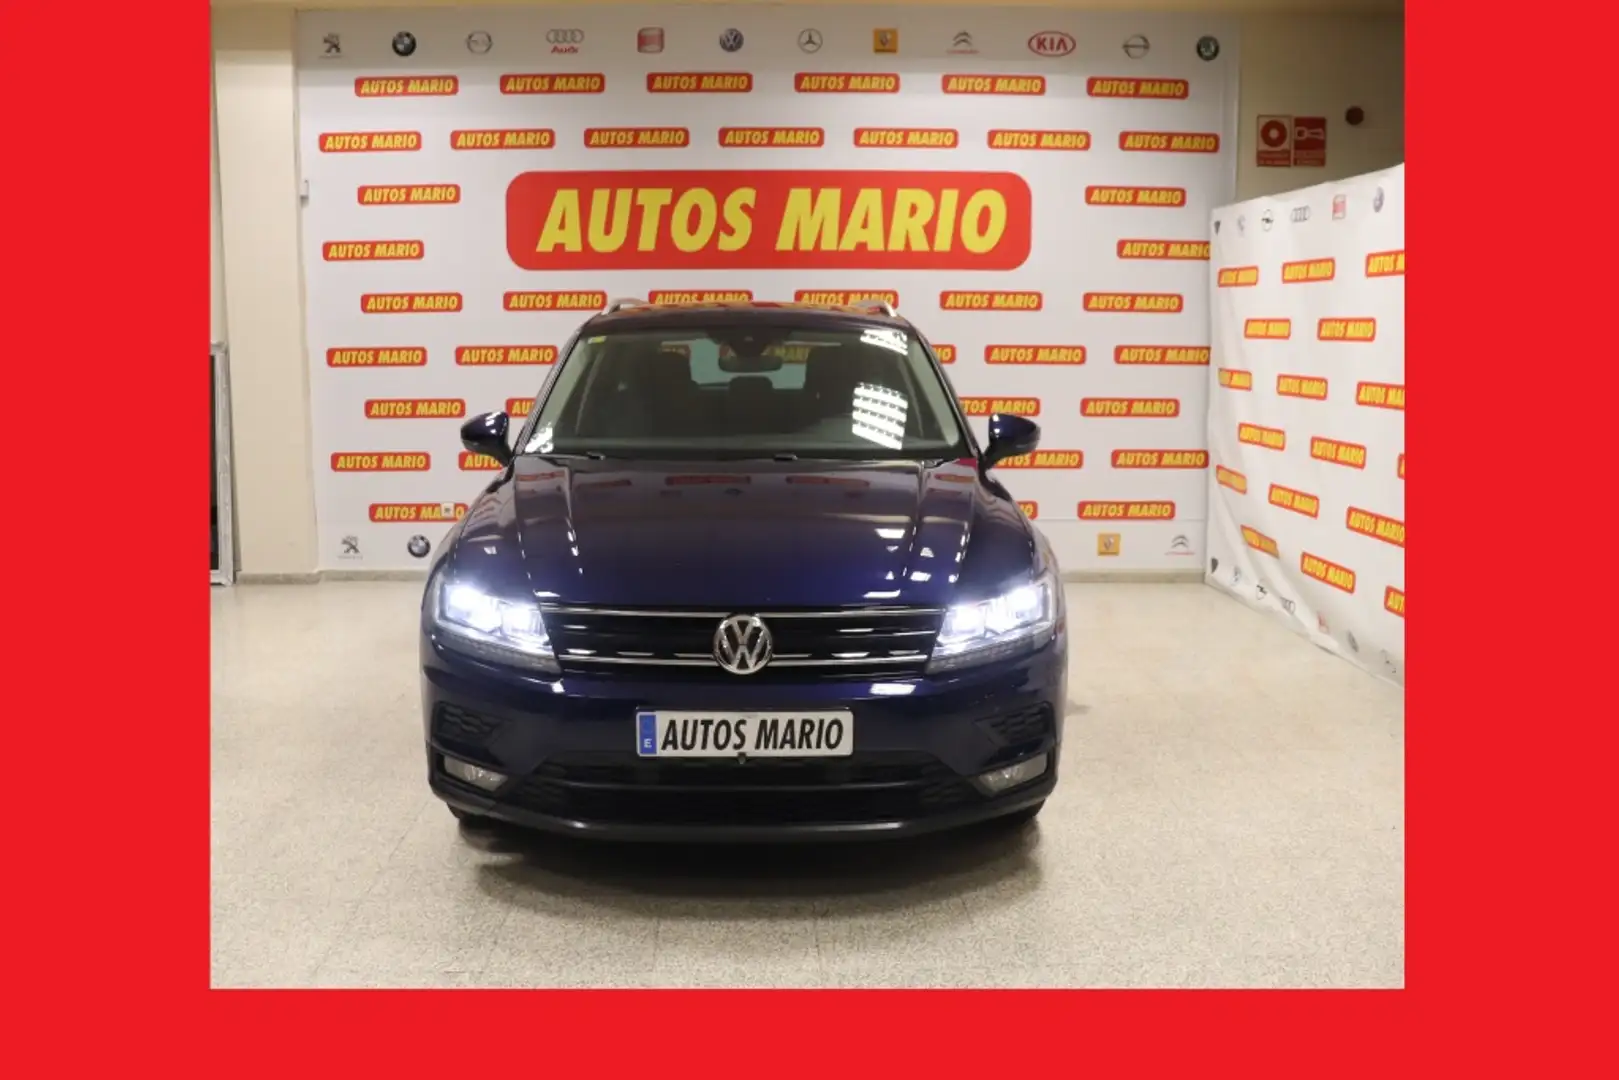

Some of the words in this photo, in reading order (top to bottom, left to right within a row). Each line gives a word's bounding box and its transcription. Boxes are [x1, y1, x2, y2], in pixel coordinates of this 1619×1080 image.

[1036, 37, 1068, 51] KIA
[361, 80, 403, 94] AUTOS
[407, 79, 453, 92] MARIO
[506, 78, 549, 91] AUTOS
[553, 78, 600, 90] MARIO
[654, 76, 697, 89] AUTOS
[701, 76, 747, 89] MARIO
[801, 77, 844, 89] AUTOS
[848, 77, 895, 90] MARIO
[948, 78, 991, 91] AUTOS
[995, 78, 1041, 92] MARIO
[1093, 81, 1135, 94] AUTOS
[1138, 82, 1182, 96] MARIO
[325, 135, 367, 150] AUTOS
[371, 134, 417, 148] MARIO
[457, 133, 500, 147] AUTOS
[504, 132, 550, 146] MARIO
[590, 132, 634, 145] AUTOS
[638, 132, 685, 145] MARIO
[725, 131, 768, 144] AUTOS
[772, 132, 819, 145] MARIO
[860, 132, 903, 145] AUTOS
[907, 132, 953, 146] MARIO
[994, 133, 1036, 147] AUTOS
[1040, 134, 1086, 148] MARIO
[1124, 135, 1166, 149] AUTOS
[1169, 136, 1213, 150] MARIO
[364, 189, 406, 203] AUTOS
[410, 188, 455, 202] MARIO
[1091, 190, 1132, 203] AUTOS
[1136, 191, 1181, 204] MARIO
[536, 186, 757, 253] AUTOS
[775, 186, 1008, 254] MARIO
[329, 244, 370, 258] AUTOS
[374, 243, 419, 257] MARIO
[1122, 243, 1165, 257] AUTOS
[367, 297, 409, 311] AUTOS
[413, 296, 458, 309] MARIO
[509, 294, 552, 309] AUTOS
[556, 294, 603, 308] MARIO
[946, 294, 988, 308] AUTOS
[992, 294, 1038, 308] MARIO
[1089, 295, 1130, 309] AUTOS
[1134, 296, 1179, 310] MARIO
[332, 350, 373, 364] AUTOS
[377, 350, 422, 364] MARIO
[462, 349, 504, 363] AUTOS
[508, 349, 553, 362] MARIO
[990, 348, 1032, 362] AUTOS
[1036, 348, 1081, 362] MARIO
[1119, 348, 1162, 362] AUTOS
[1165, 349, 1209, 363] MARIO
[370, 402, 412, 416] AUTOS
[416, 402, 461, 415] MARIO
[961, 400, 987, 413] TOS
[990, 400, 1036, 414] MARIO
[1086, 401, 1128, 415] AUTOS
[1131, 401, 1175, 415] MARIO
[336, 455, 378, 469] AUTOS
[381, 455, 425, 468] MARIO
[1035, 453, 1080, 467] MARIO
[1116, 453, 1158, 466] AUTOS
[1161, 453, 1205, 467] MARIO
[374, 505, 417, 519] AUTOS
[1083, 504, 1124, 517] AUTOS
[1127, 504, 1170, 517] MARIO
[661, 718, 748, 751] AUTOS
[754, 717, 844, 750] MARIO
